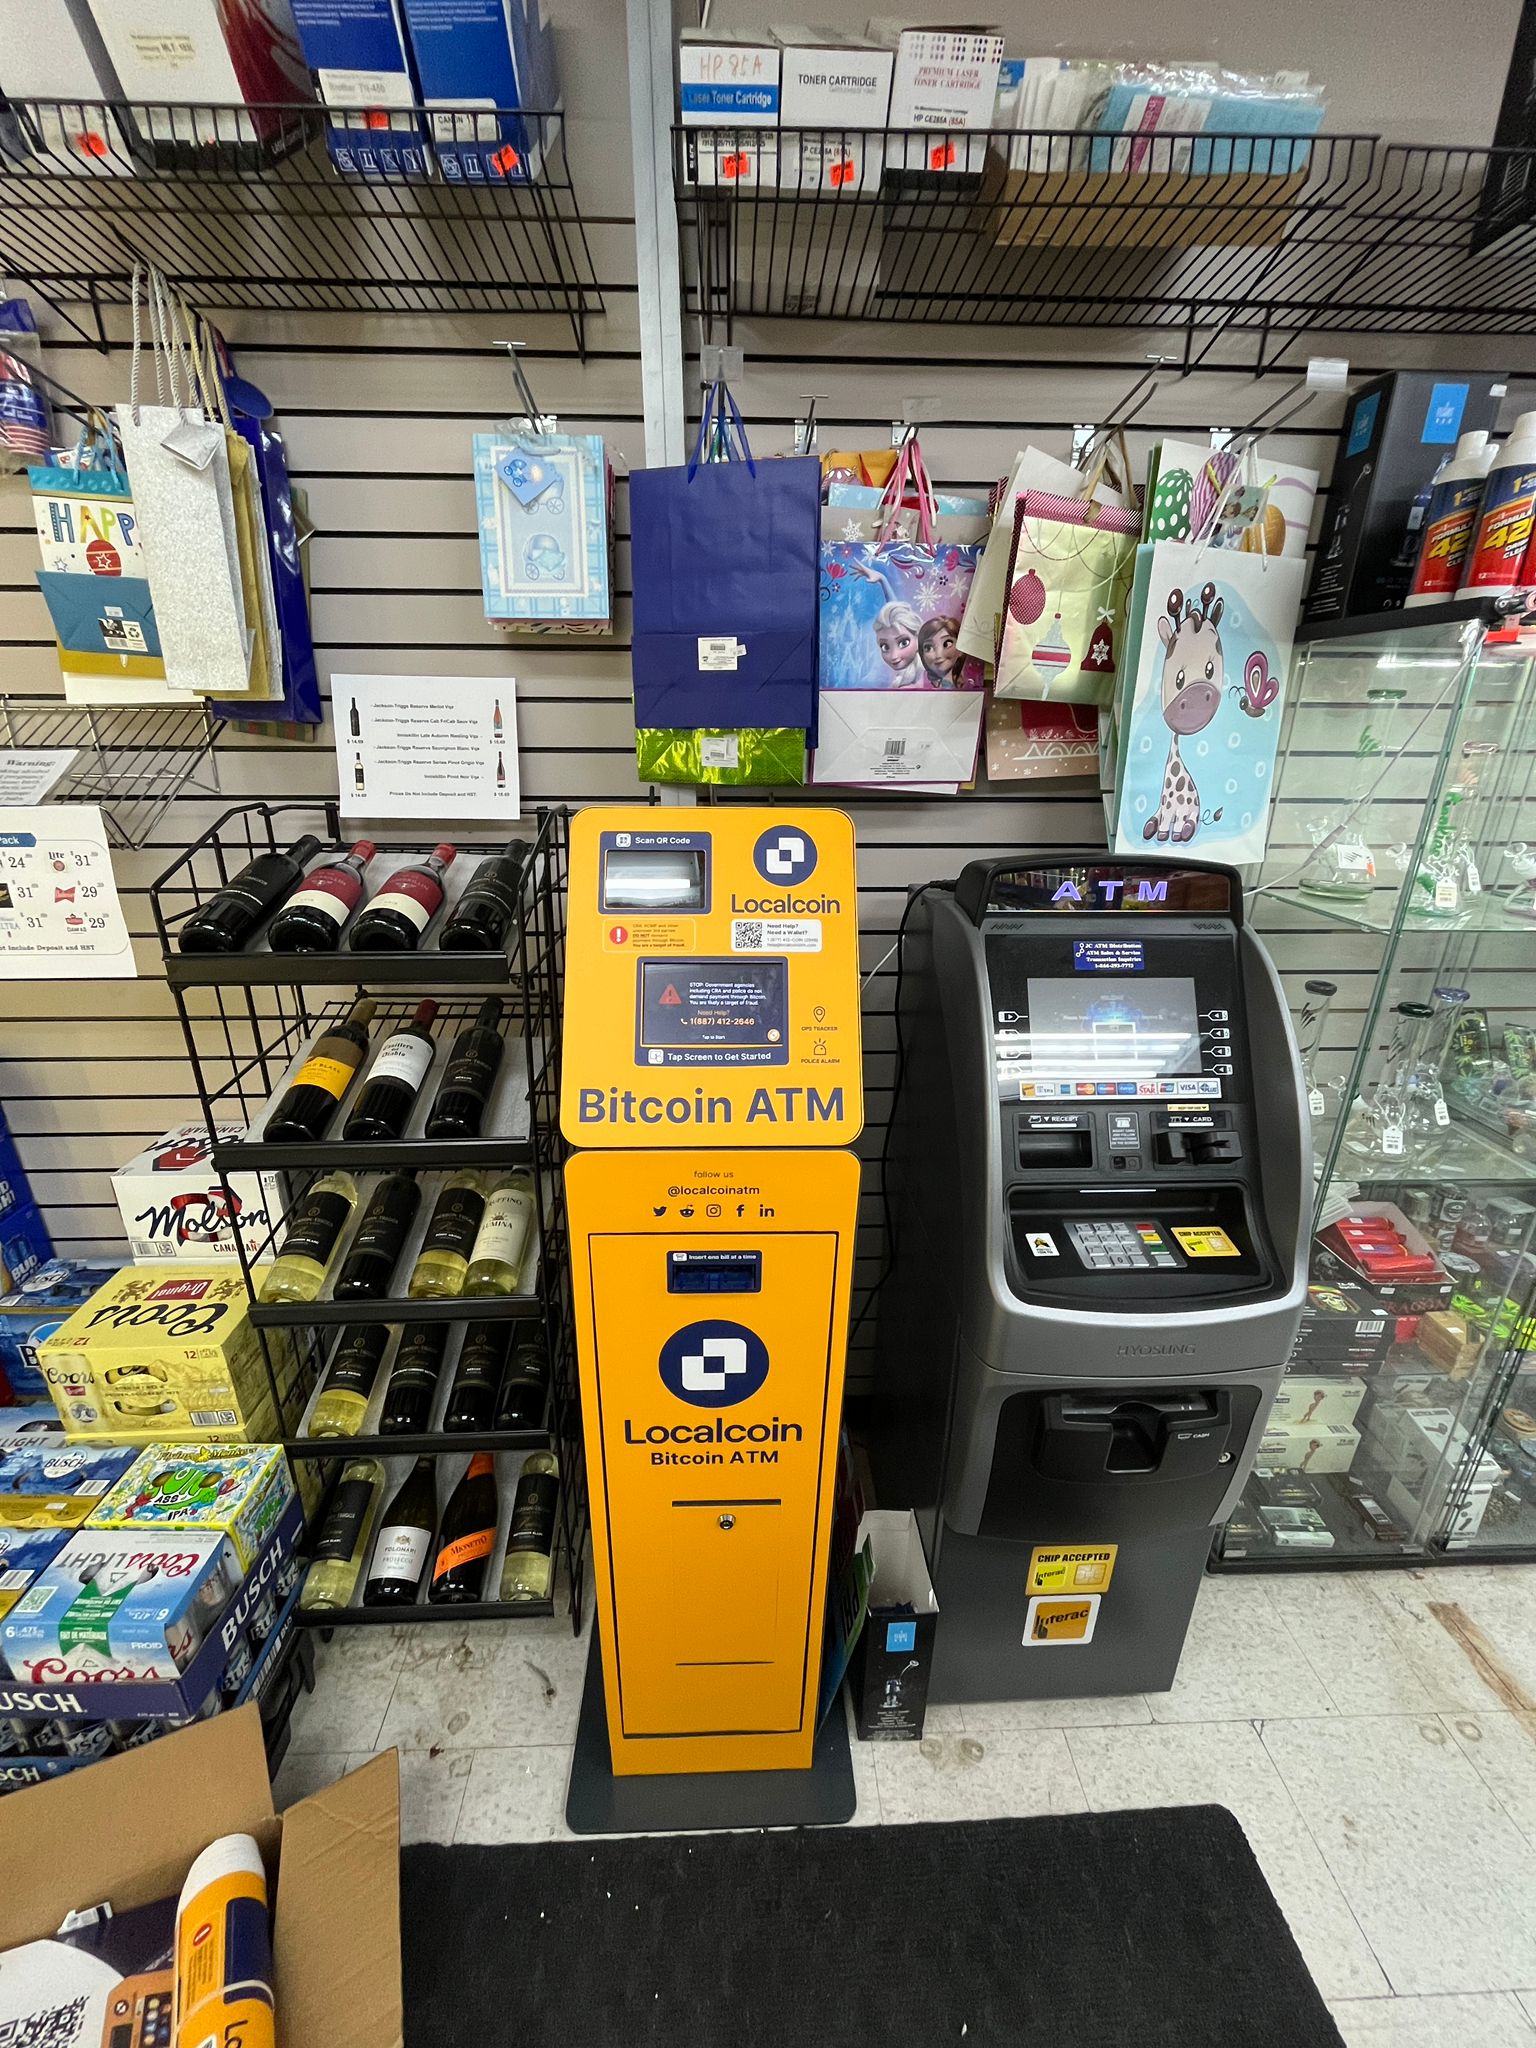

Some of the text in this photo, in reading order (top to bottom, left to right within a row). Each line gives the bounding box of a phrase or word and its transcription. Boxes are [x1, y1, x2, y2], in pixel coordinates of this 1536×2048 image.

[799, 74, 877, 87] TONER CARTRIDGE
[712, 91, 734, 104] Toner
[735, 91, 772, 108] Cartridge
[913, 113, 924, 123] HP
[49, 502, 136, 546] HAPP
[656, 837, 668, 845] QR
[8, 857, 26, 868] 24
[75, 855, 91, 867] 31
[17, 886, 98, 898] 31 29
[731, 893, 841, 914] Localcoin
[27, 917, 43, 928] 31
[89, 918, 106, 929] 29
[667, 1053, 683, 1062] Tap
[684, 1053, 713, 1061] Screen
[724, 1053, 740, 1061] Get
[741, 1052, 772, 1061] Started
[1139, 1085, 1157, 1094] STAR
[1179, 1084, 1197, 1092] VISA
[578, 1086, 843, 1123] Bitcoin ATM
[667, 1185, 760, 1197] @localcoinatm
[11, 1254, 38, 1282] BUD
[153, 1280, 207, 1299] Original
[85, 1303, 228, 1337] Coors
[183, 1350, 197, 1359] 12
[1116, 1344, 1197, 1356] HYOSUNG
[46, 1367, 95, 1384] Coors
[624, 1417, 803, 1445] Localcoin
[207, 1435, 220, 1443] 12
[44, 1458, 86, 1468] BUSCH
[650, 1451, 779, 1465] Bitcoin ATM
[154, 1495, 179, 1504] ASS
[168, 1508, 188, 1520] IPA
[1037, 1552, 1110, 1563] CHIP ACCEPTED
[56, 1552, 200, 1577] Coors LIGHT
[1035, 1566, 1066, 1582] Interac
[220, 1537, 283, 1651] BUSCH
[1036, 1609, 1090, 1627] Interac
[5, 1626, 16, 1638] 6
[23, 1658, 161, 1683] Coors
[0, 1692, 84, 1713] USCH
